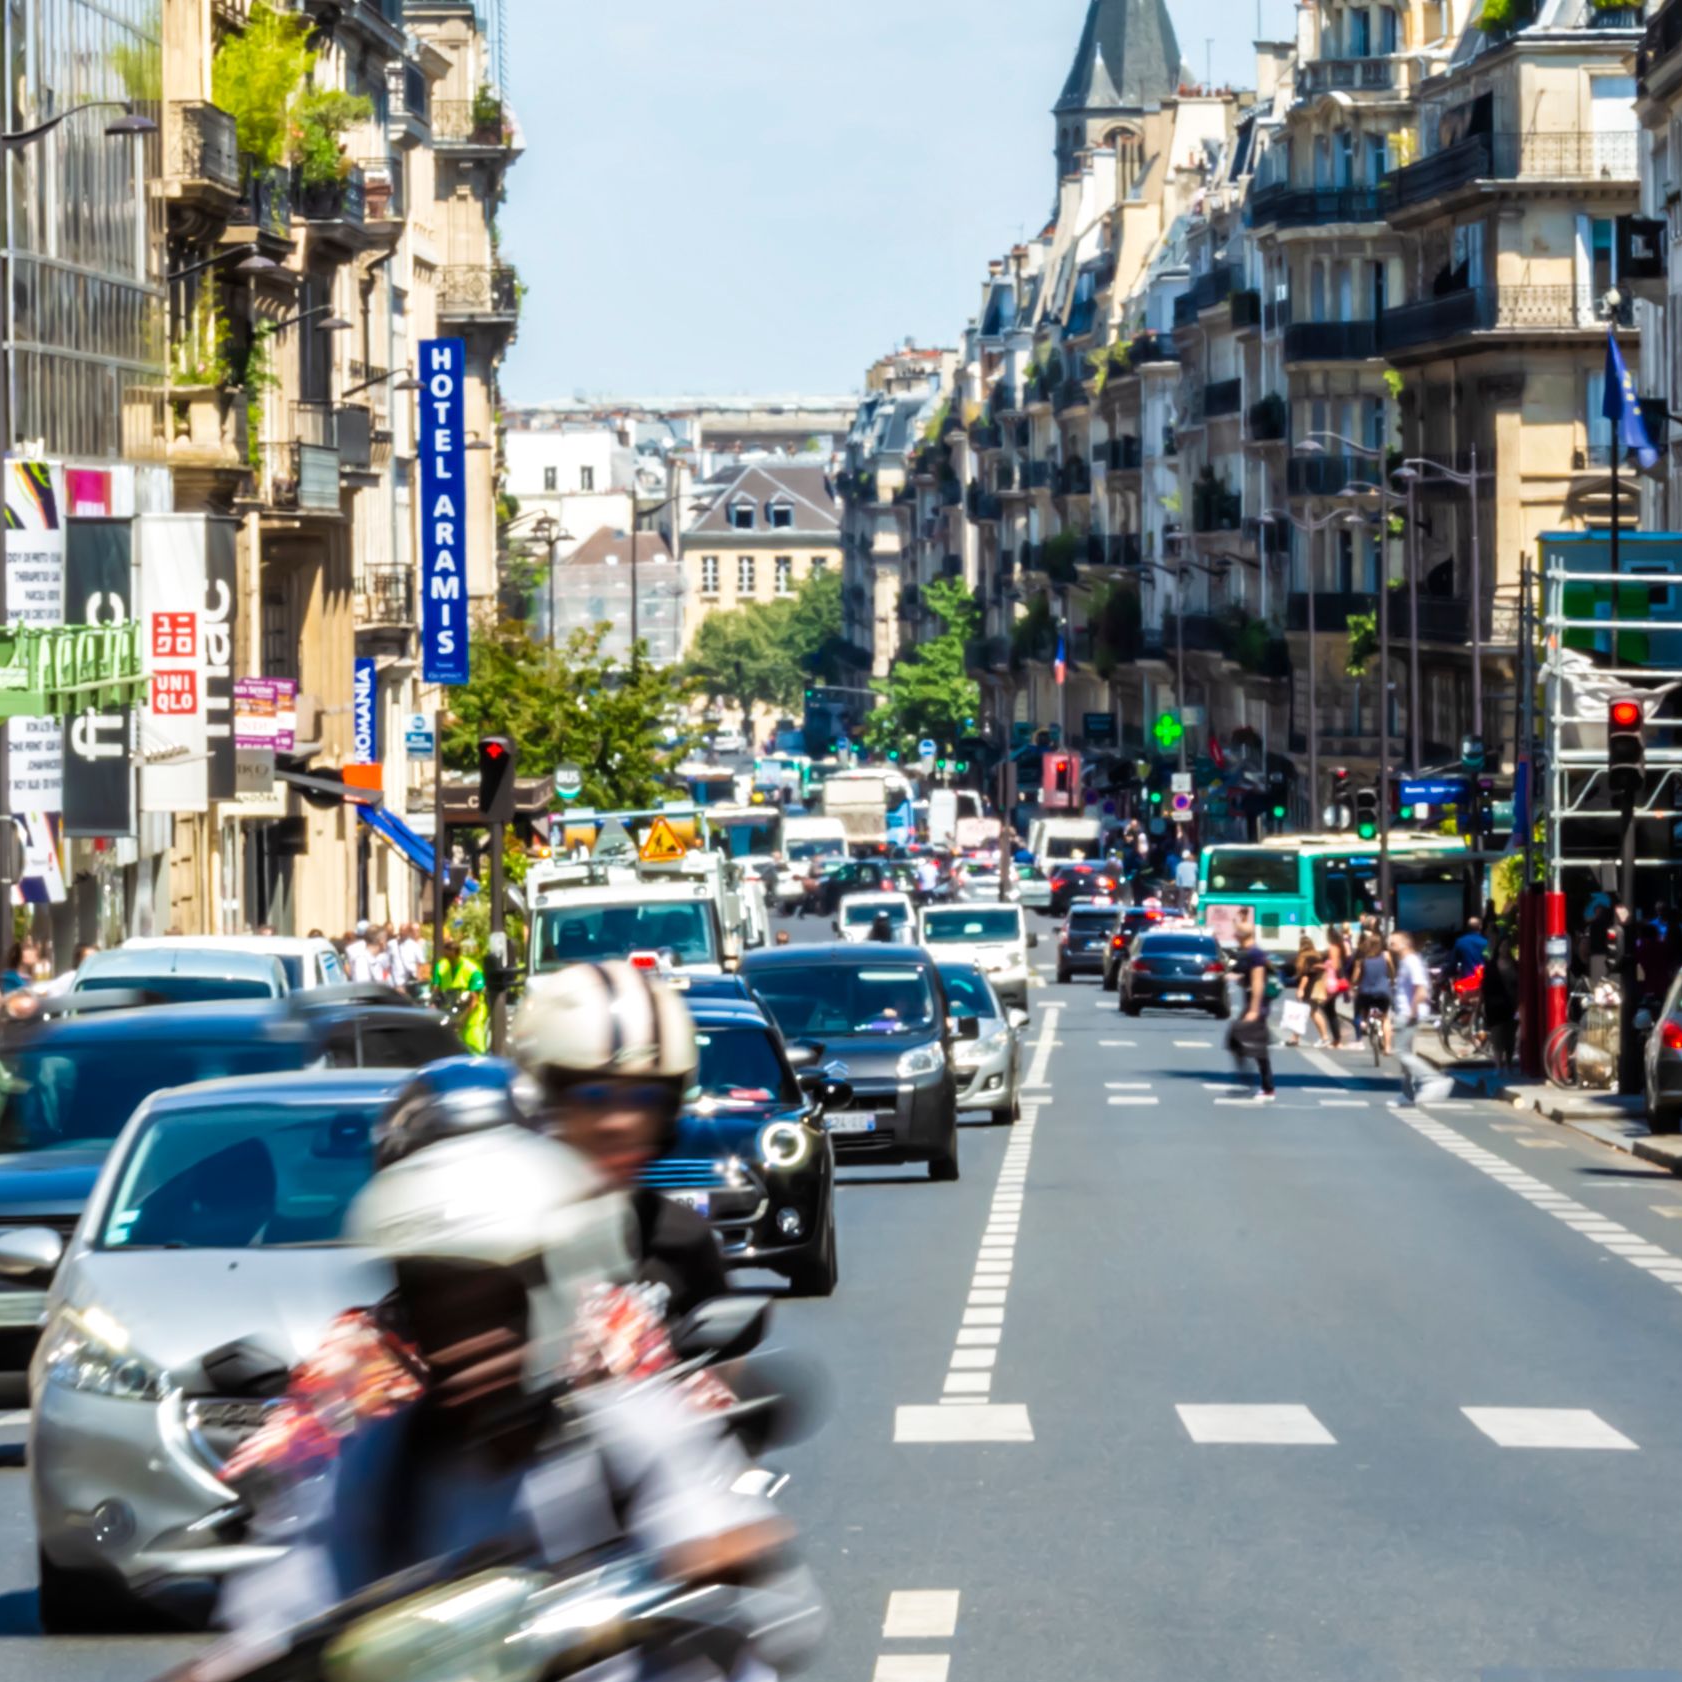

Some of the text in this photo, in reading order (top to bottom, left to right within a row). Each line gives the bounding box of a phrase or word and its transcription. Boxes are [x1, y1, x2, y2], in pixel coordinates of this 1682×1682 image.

[430, 348, 454, 479] HOTEL
[431, 494, 459, 654] ARAMIS
[557, 770, 580, 783] BUS
